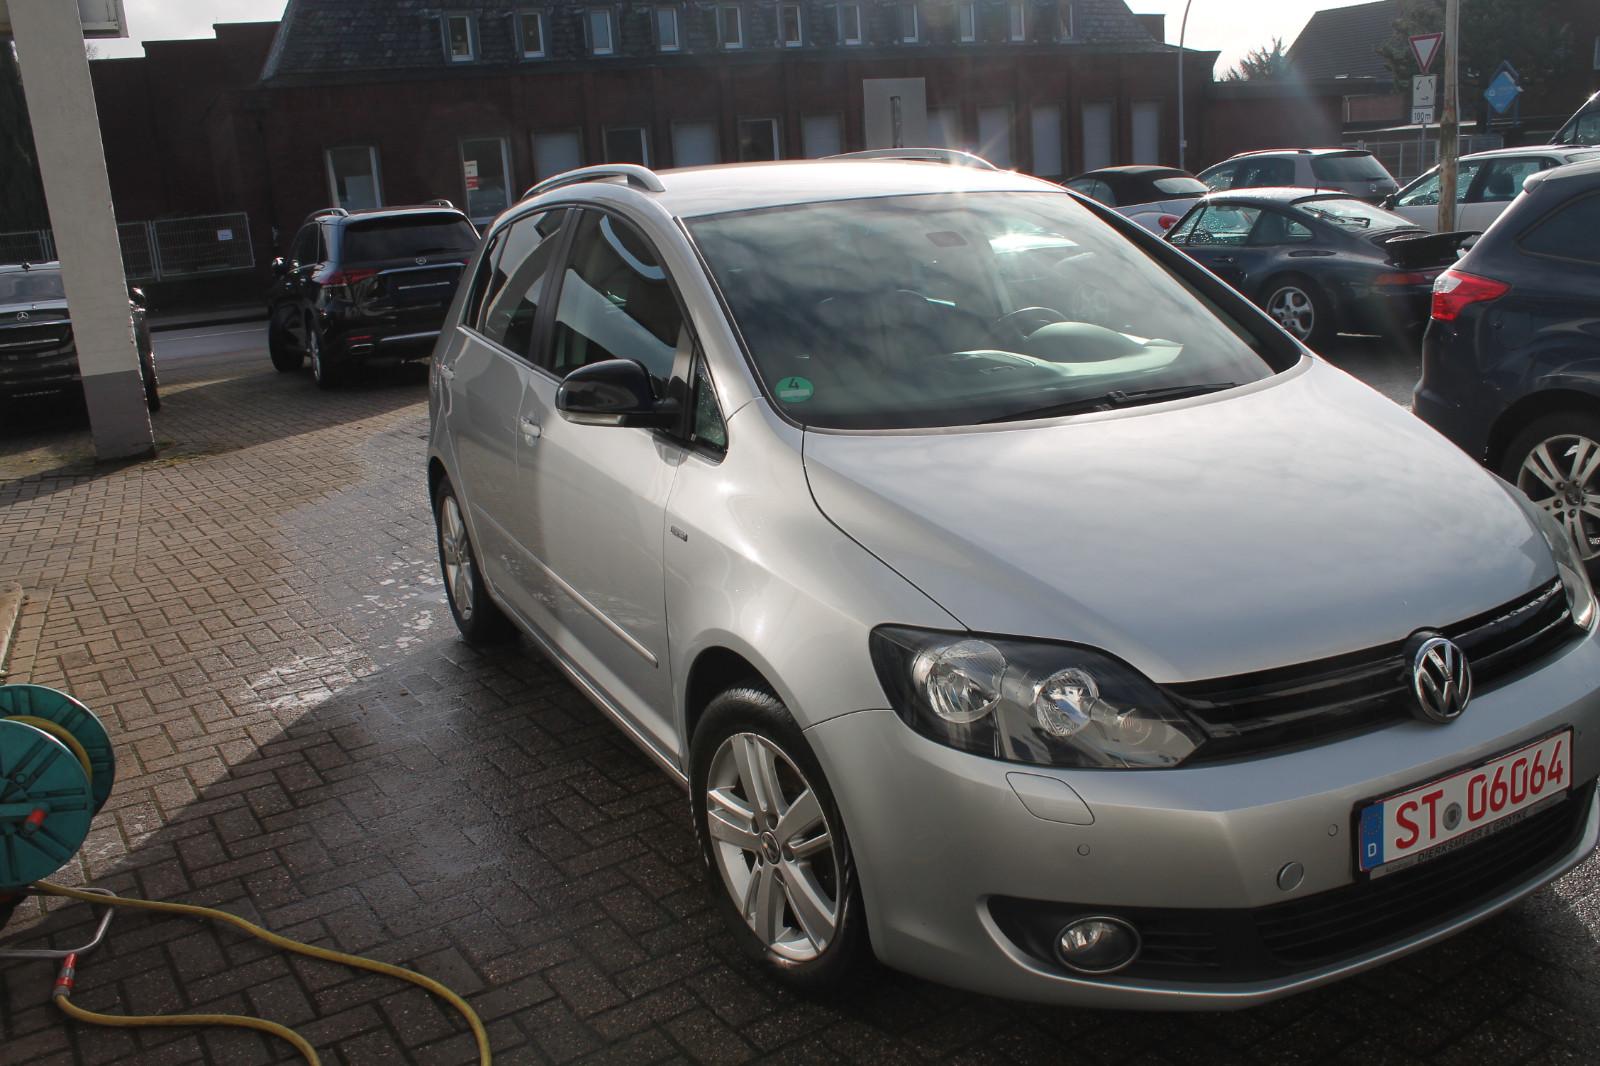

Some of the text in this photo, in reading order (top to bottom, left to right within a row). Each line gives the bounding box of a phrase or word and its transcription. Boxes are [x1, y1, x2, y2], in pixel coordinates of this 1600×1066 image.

[788, 378, 800, 389] 4
[1395, 740, 1564, 849] ST 06064
[1368, 843, 1376, 857] D
